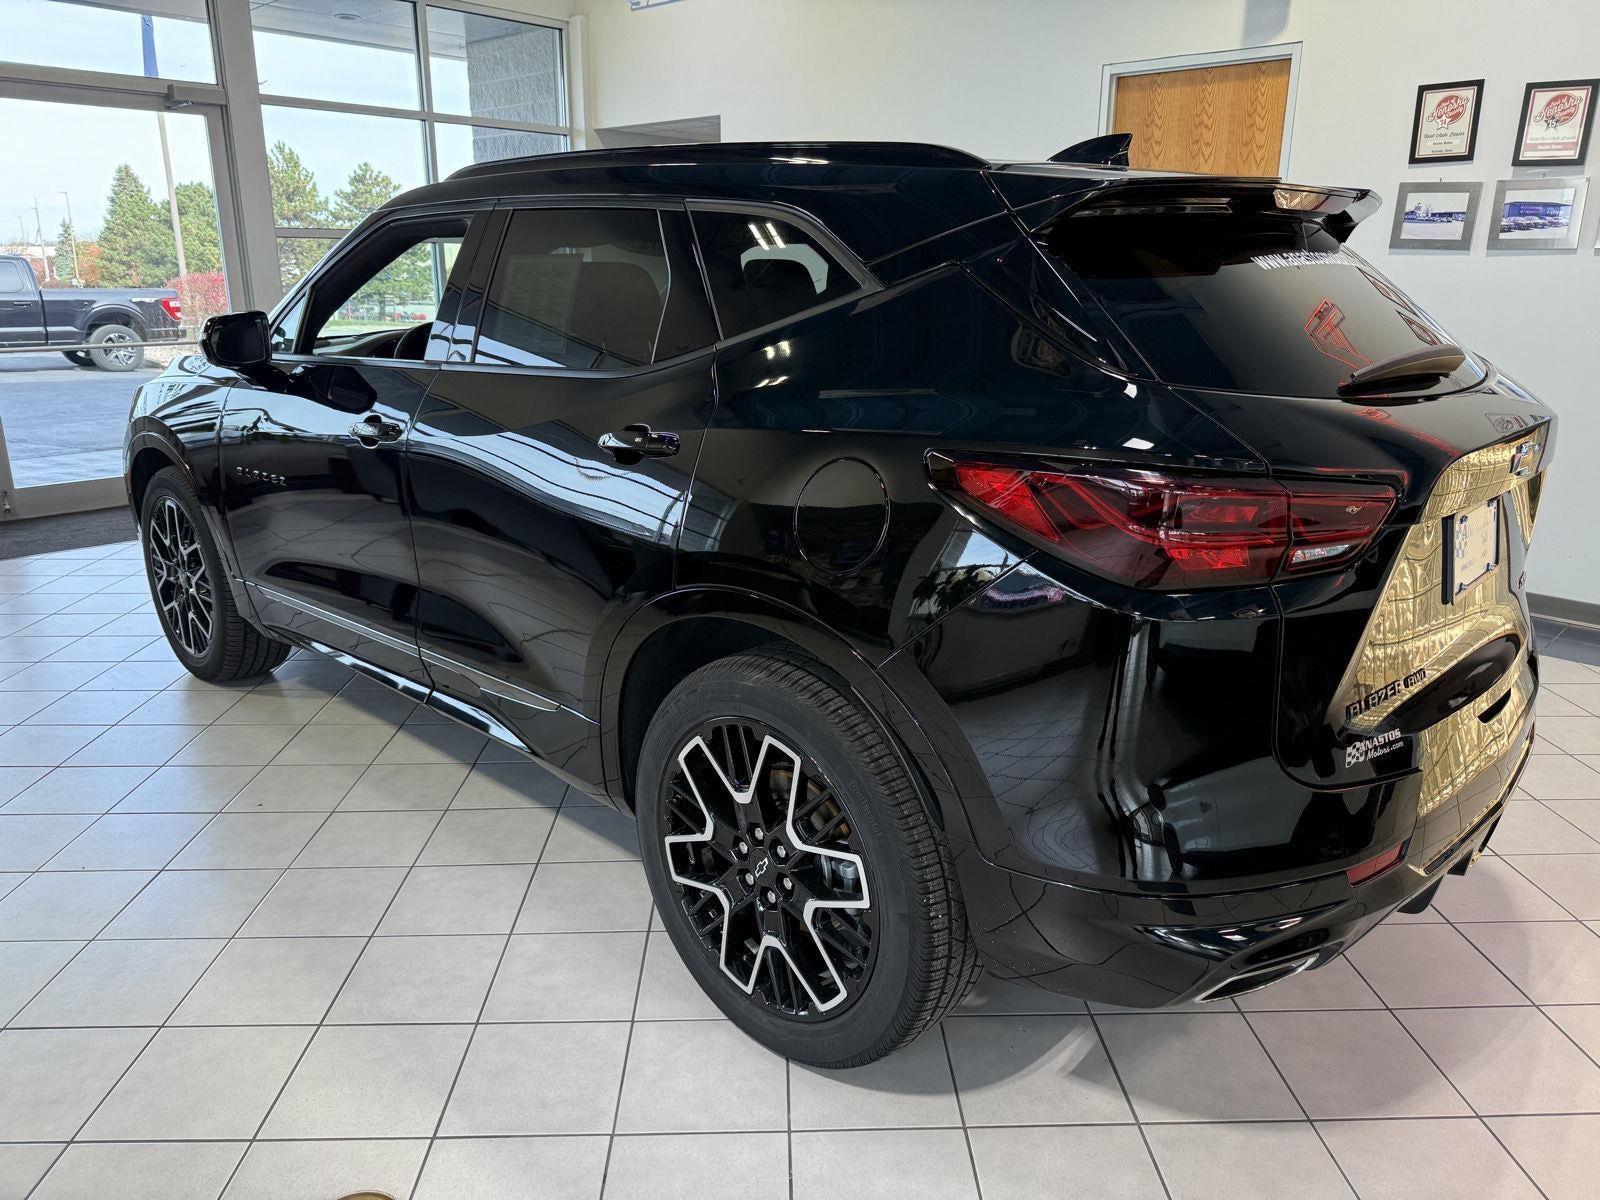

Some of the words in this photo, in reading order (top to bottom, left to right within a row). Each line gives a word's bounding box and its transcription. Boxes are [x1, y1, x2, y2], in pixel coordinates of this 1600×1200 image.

[1346, 680, 1404, 720] BLAZER
[1359, 728, 1402, 753] ANASTOS
[1367, 741, 1404, 760] Motors.com
